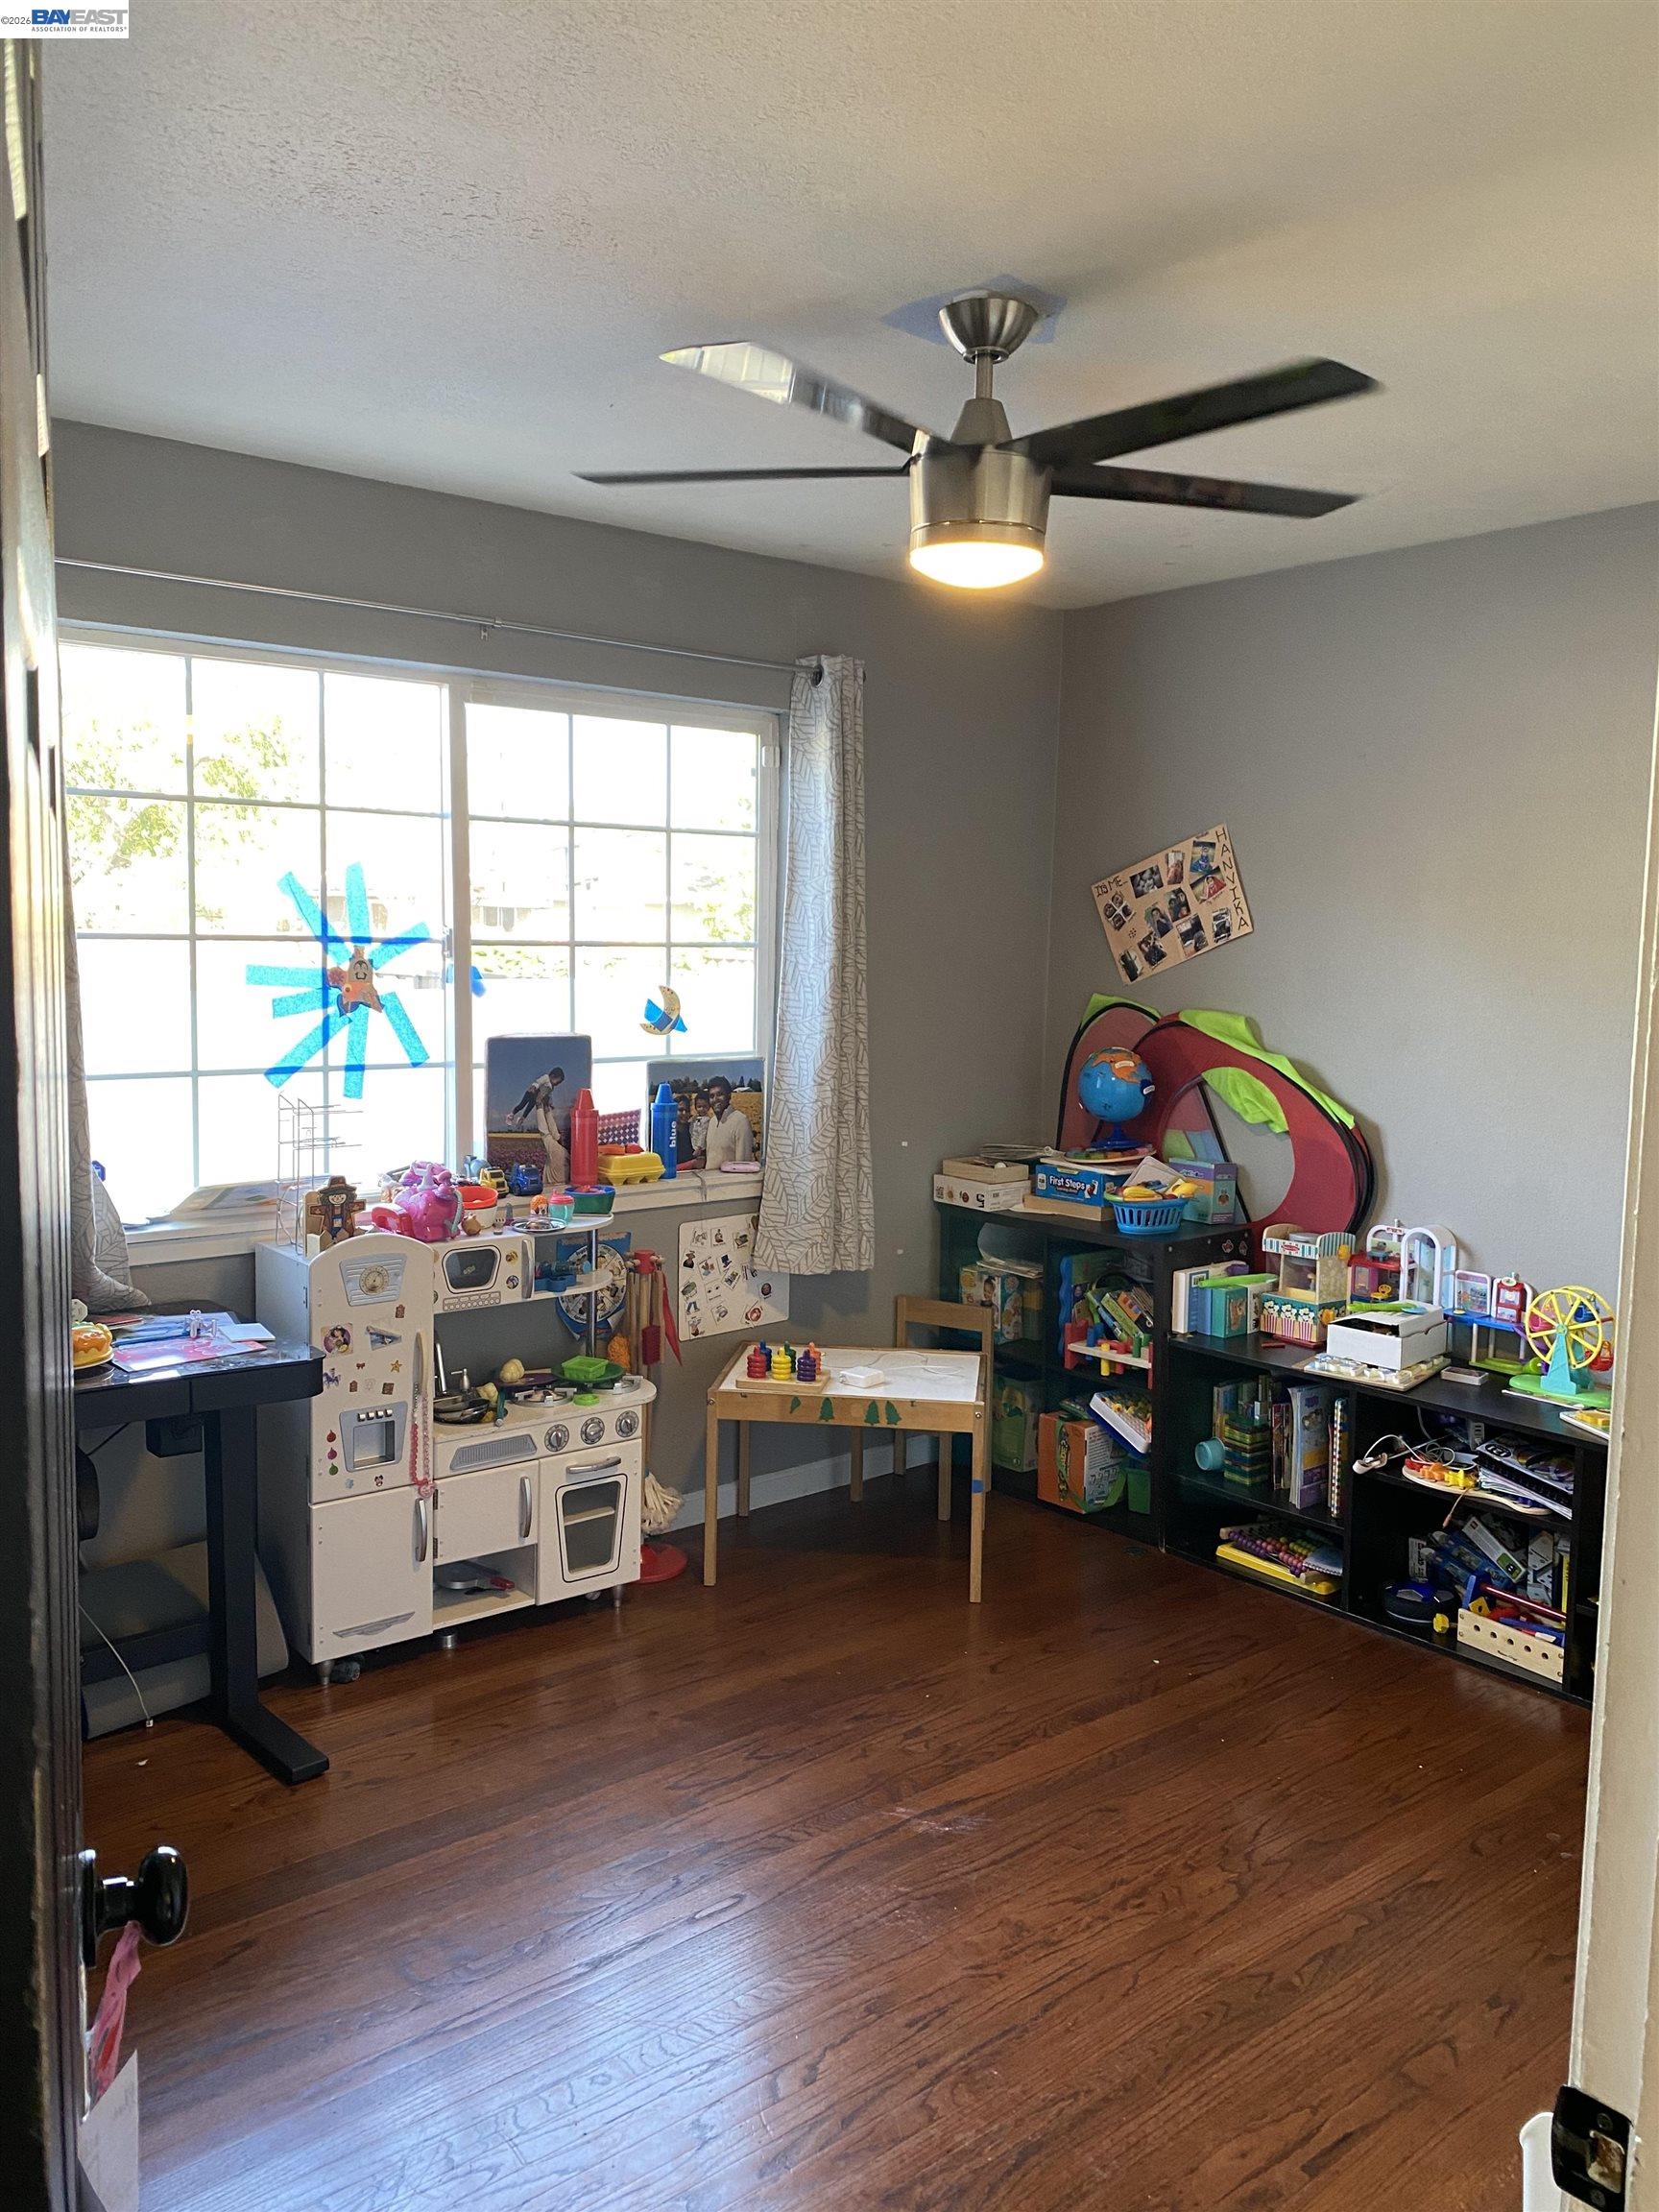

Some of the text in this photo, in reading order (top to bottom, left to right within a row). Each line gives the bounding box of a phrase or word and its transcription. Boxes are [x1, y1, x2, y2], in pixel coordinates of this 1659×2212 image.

[1215, 827, 1249, 930] HANVIKA
[1049, 1175, 1065, 1187] First
[1065, 1178, 1086, 1190] Steps
